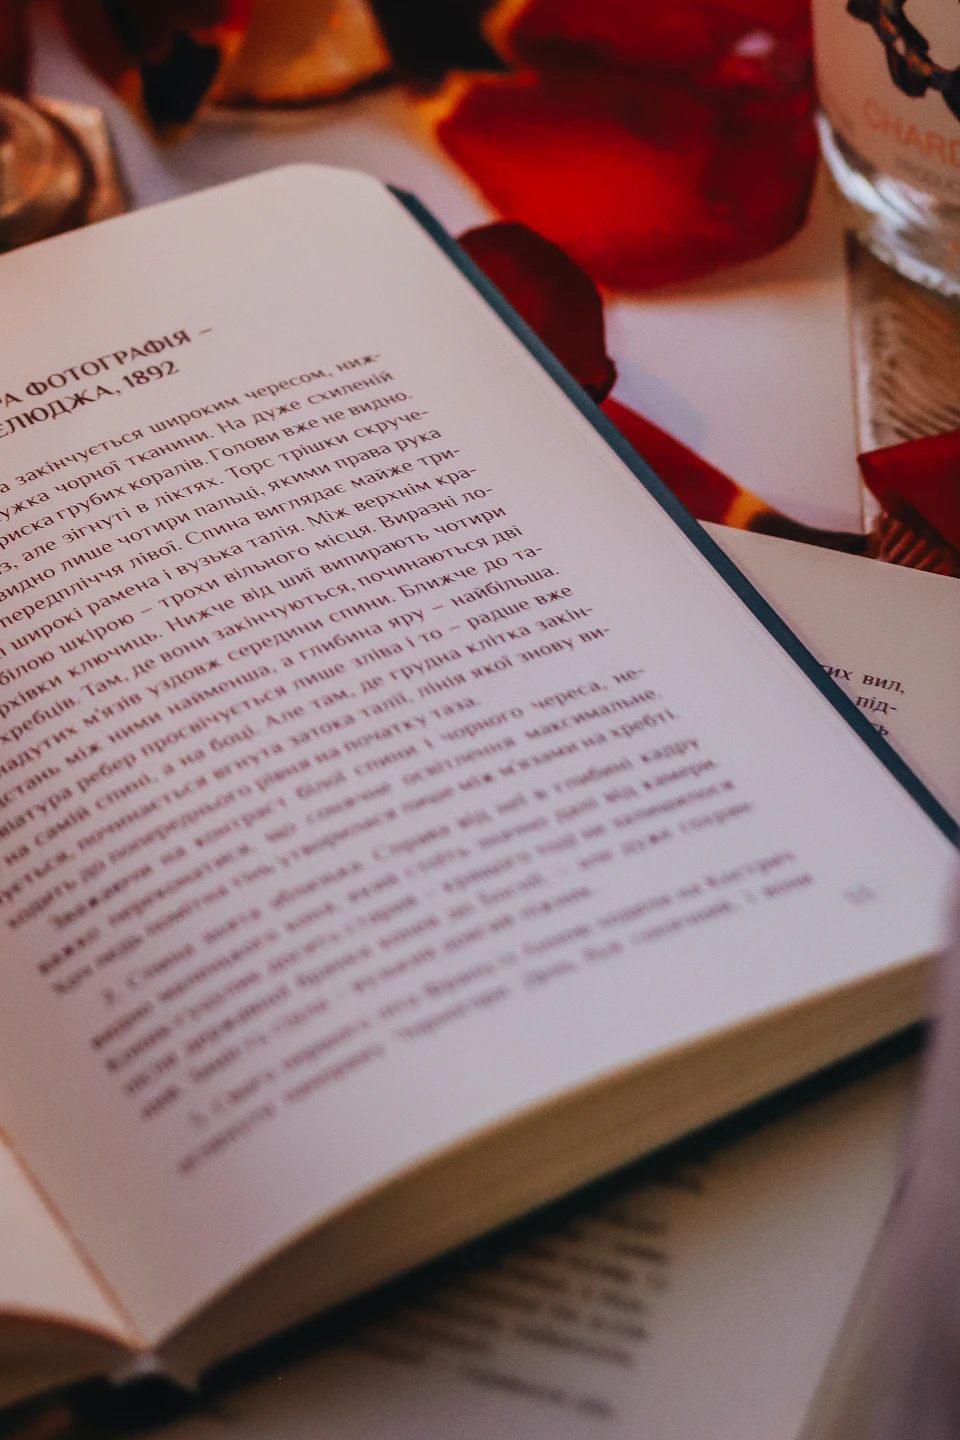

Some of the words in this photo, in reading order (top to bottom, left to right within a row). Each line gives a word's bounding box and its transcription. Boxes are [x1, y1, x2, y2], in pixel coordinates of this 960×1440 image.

[14, 429, 145, 486] закінчується
[148, 396, 241, 434] широким
[243, 369, 334, 400] чересом,
[334, 354, 381, 373] ниж-
[24, 329, 192, 397] ФОТОГРАФІЯ
[122, 360, 180, 388] 1892
[21, 540, 58, 563] але
[61, 507, 132, 544] зігнуті
[134, 503, 150, 514] в
[154, 477, 225, 508] ліктях.
[224, 458, 275, 479] Торс
[277, 433, 350, 462] трішки
[353, 410, 429, 439] скруче-
[54, 459, 122, 493] чорної
[124, 431, 215, 466] тканини.
[215, 418, 247, 434] На
[251, 400, 302, 426] дуже
[306, 371, 395, 405] схиленій
[55, 486, 127, 520] грубих
[127, 458, 209, 492] коралів.
[207, 431, 281, 461] Голови
[280, 418, 320, 438] вже
[320, 410, 346, 425] не
[346, 391, 413, 417] видно.
[9, 607, 84, 651] широкі
[85, 576, 161, 617] рамена
[161, 568, 173, 581] і
[174, 544, 244, 576] вузька
[246, 523, 305, 548] талія.
[305, 507, 351, 528] Між
[352, 481, 433, 513] верхнім
[433, 468, 477, 486] кра-
[60, 542, 114, 572] лише
[116, 512, 192, 545] чотири
[193, 485, 266, 518] пальці,
[267, 463, 332, 492] якими
[333, 444, 393, 469] права
[393, 429, 442, 453] рука
[128, 539, 183, 569] лівої.
[184, 516, 251, 545] Спина
[253, 483, 347, 521] виглядає
[349, 462, 414, 488] майже
[416, 449, 461, 467] три-
[58, 613, 135, 654] шкірою
[157, 578, 221, 608] трохи
[222, 546, 311, 584] вільного
[314, 524, 377, 551] місця.
[376, 494, 459, 529] Виразні
[461, 488, 493, 503] ло-
[66, 632, 163, 679] ключиць.
[164, 598, 235, 632] Нижче
[240, 585, 277, 603] від
[277, 566, 316, 589] шиї
[318, 533, 430, 575] випирають
[432, 507, 507, 534] чотири
[131, 658, 156, 679] де
[158, 635, 210, 663] вони
[356, 537, 490, 587] починаються
[491, 524, 523, 546] дві
[227, 618, 324, 662] середини
[397, 566, 478, 598] Ближче
[482, 556, 509, 574] до
[511, 547, 543, 561] та-
[856, 696, 898, 715] під-
[862, 674, 905, 695] вил,
